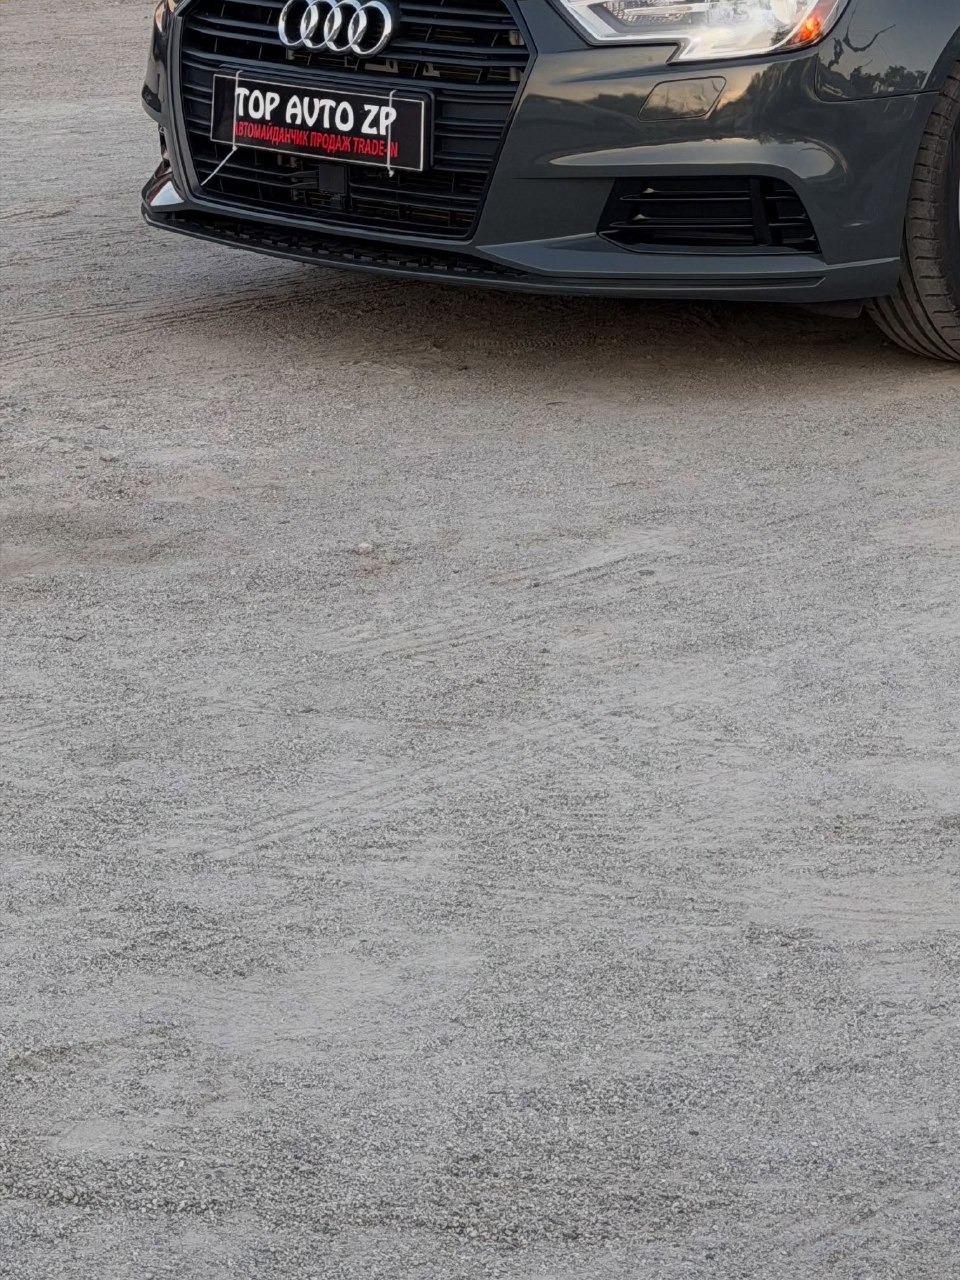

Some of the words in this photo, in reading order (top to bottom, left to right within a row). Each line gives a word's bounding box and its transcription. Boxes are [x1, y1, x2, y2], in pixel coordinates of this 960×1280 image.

[235, 87, 280, 120] TOP
[361, 104, 397, 136] ZP
[309, 131, 351, 154] ПРОДАЖ
[352, 136, 399, 158] TRADE-N
